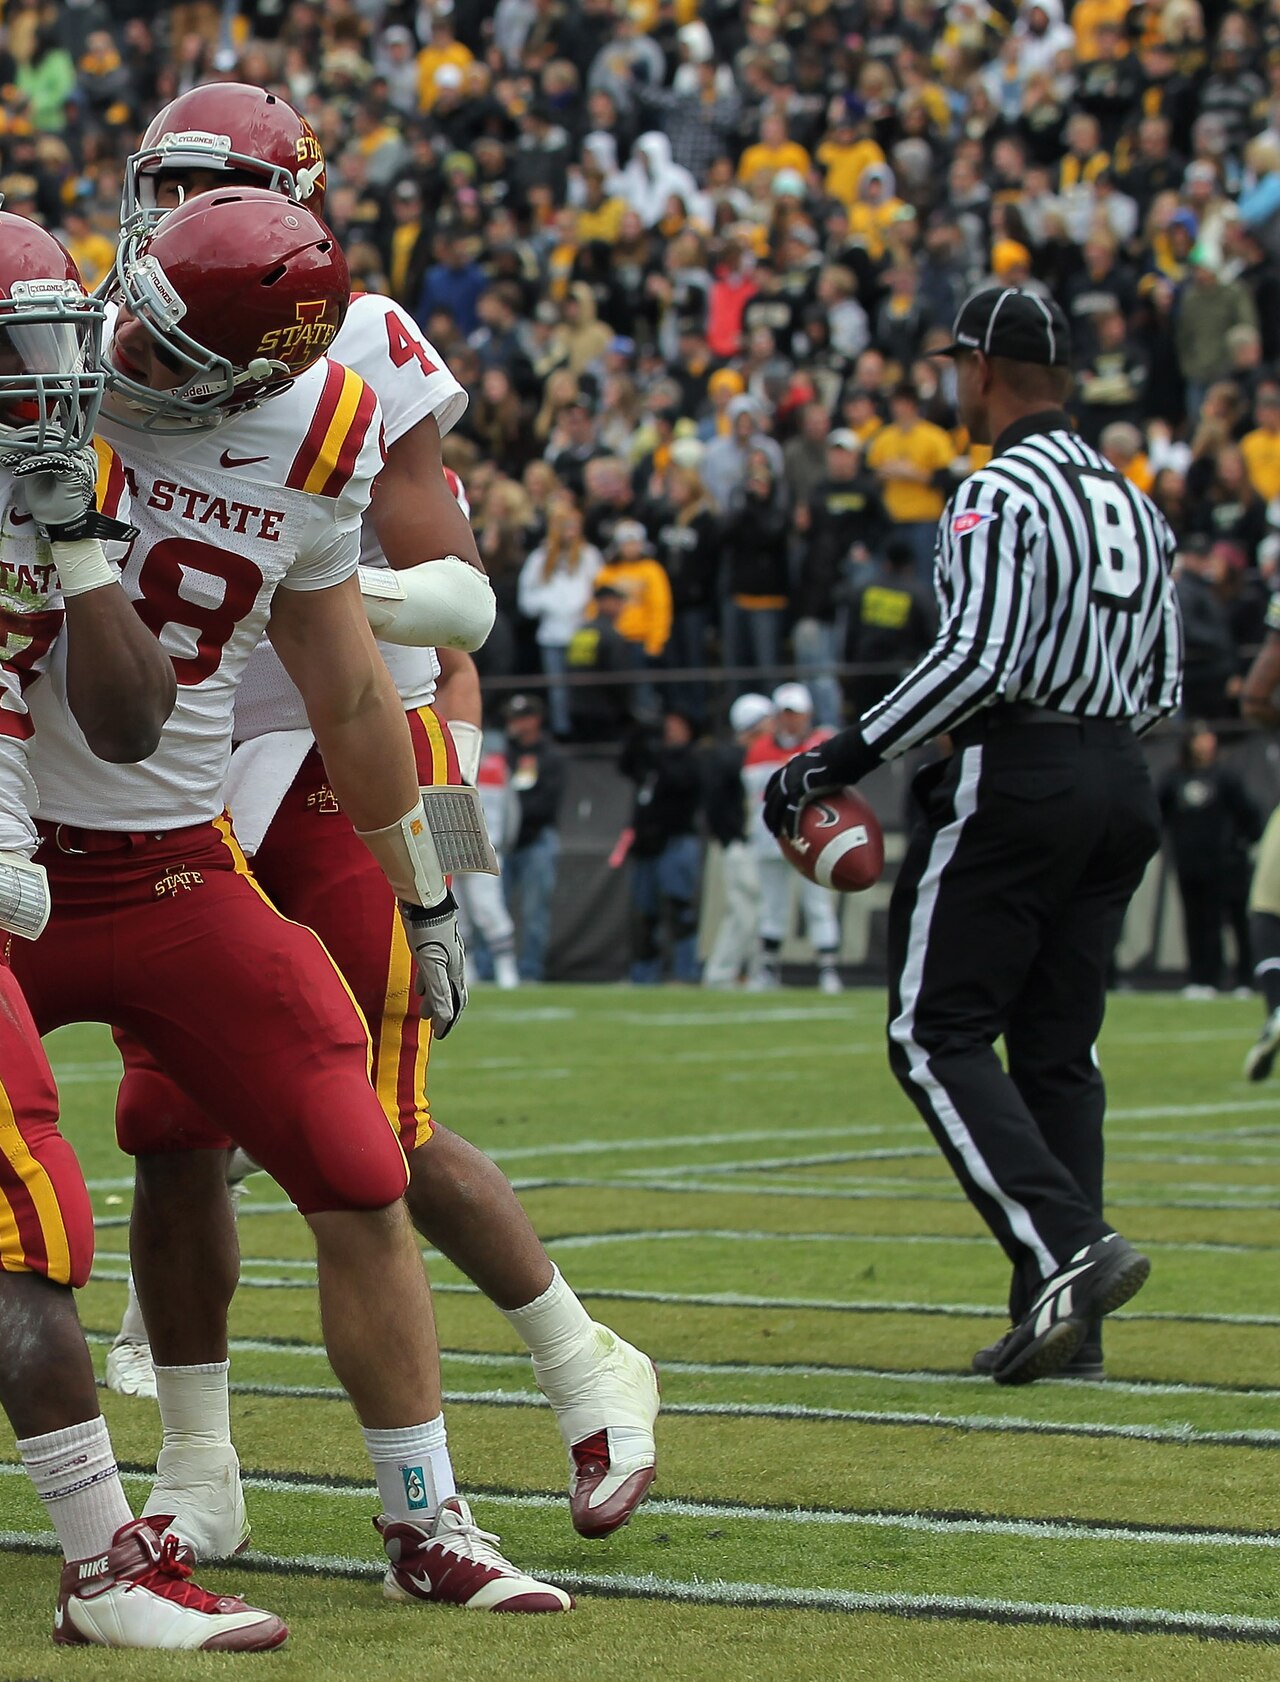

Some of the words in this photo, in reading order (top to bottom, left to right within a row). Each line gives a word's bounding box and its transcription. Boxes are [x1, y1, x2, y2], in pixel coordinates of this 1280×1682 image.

[178, 136, 214, 146] CYCLONES
[30, 284, 64, 293] CYCLONES
[149, 271, 173, 304] CYCLONES
[256, 323, 337, 353] STATE
[384, 310, 439, 377] 4
[147, 479, 286, 542] STATE
[1079, 474, 1142, 598] B
[119, 536, 264, 686] 8
[154, 871, 205, 897] STATE
[78, 1555, 109, 1580] NIKE
